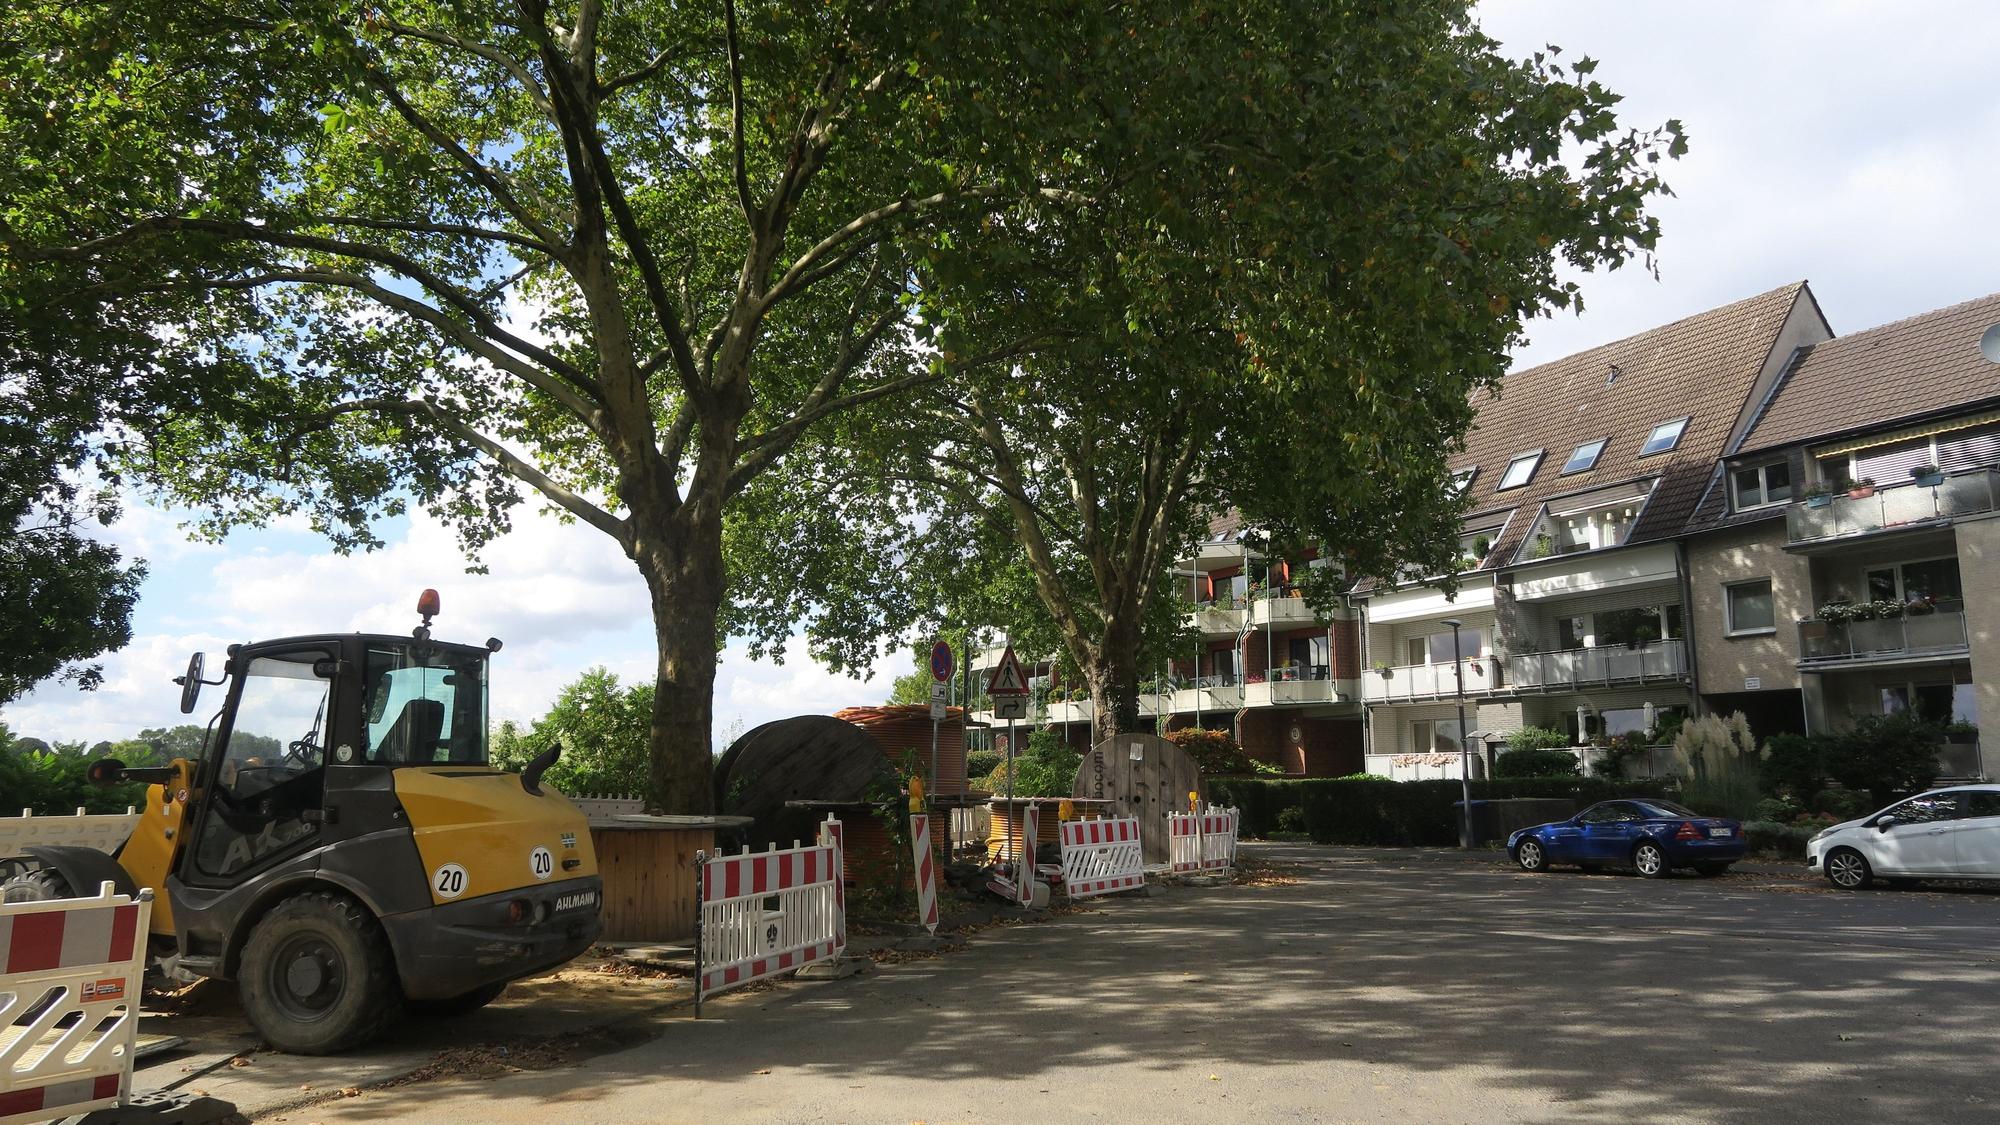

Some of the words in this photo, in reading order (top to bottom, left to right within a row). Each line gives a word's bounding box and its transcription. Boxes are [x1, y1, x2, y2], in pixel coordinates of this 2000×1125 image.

[534, 852, 550, 874] 20
[438, 869, 463, 893] 20
[555, 891, 595, 911] AHLMANN
